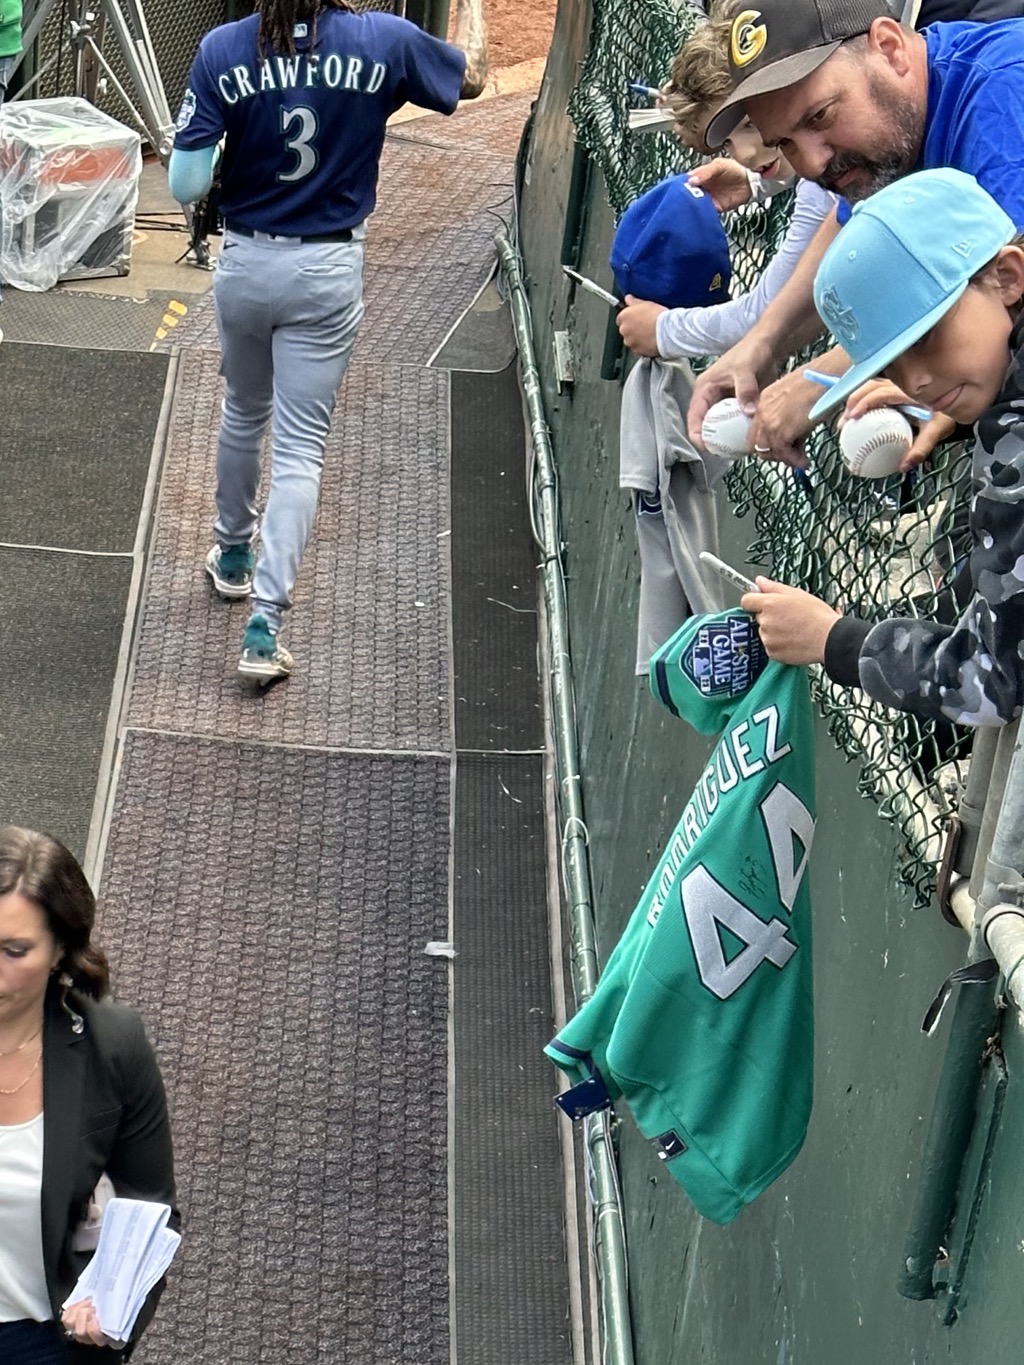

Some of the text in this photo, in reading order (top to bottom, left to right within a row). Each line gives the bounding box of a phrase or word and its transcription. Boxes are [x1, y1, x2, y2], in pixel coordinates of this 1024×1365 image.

[218, 54, 387, 104] CRAWFORD
[278, 105, 320, 184] 3
[712, 634, 732, 685] GAME
